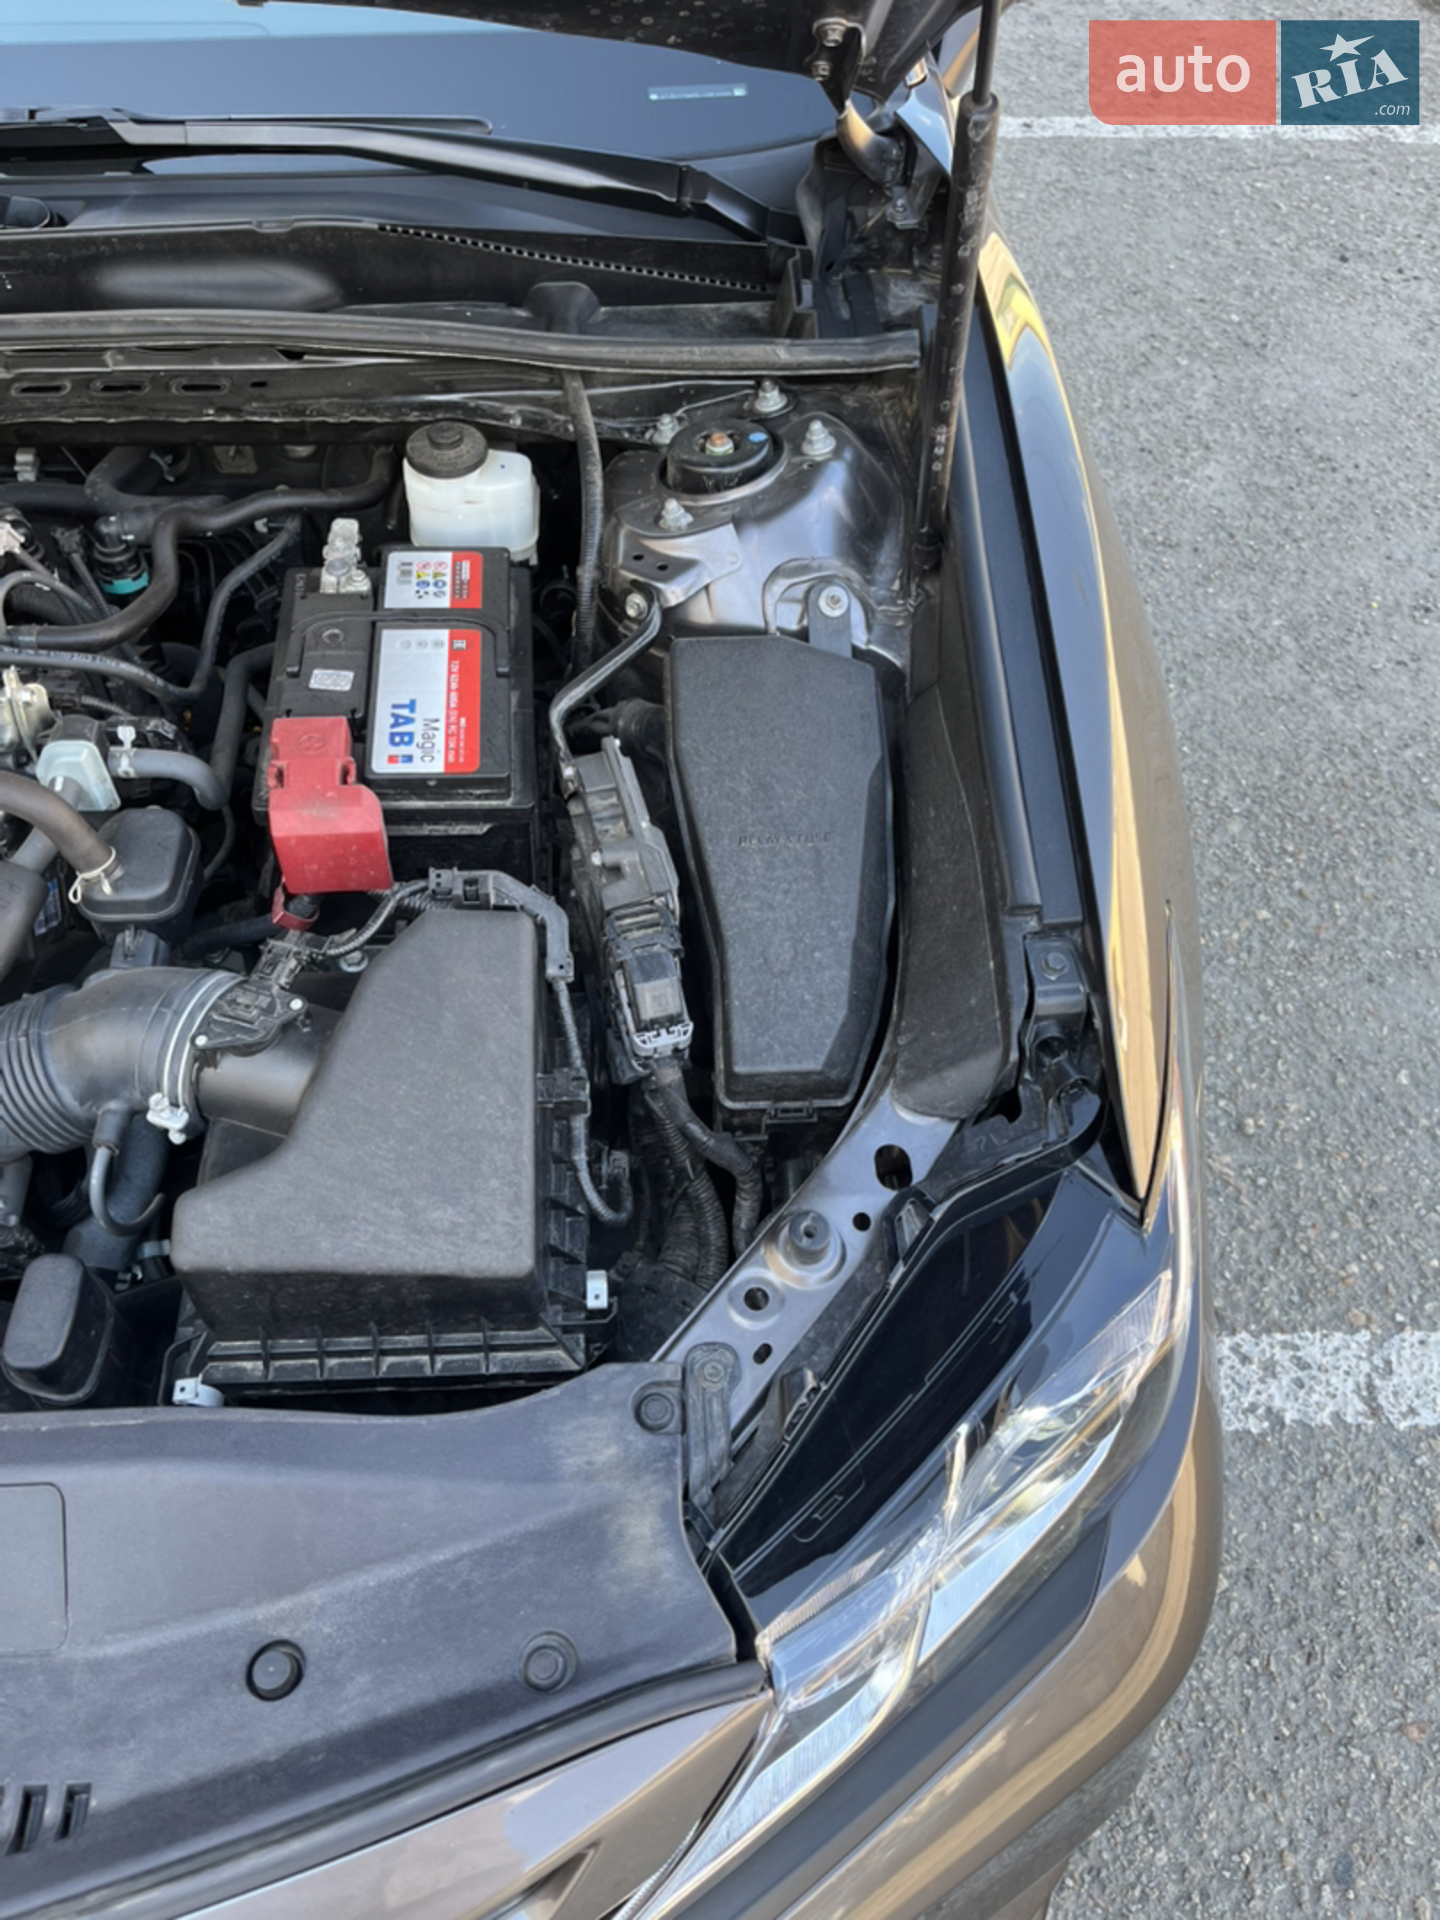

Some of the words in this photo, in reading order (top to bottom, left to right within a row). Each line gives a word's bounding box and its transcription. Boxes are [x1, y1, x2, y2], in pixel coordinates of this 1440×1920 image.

[450, 660, 459, 673] 12V
[388, 699, 417, 747] TAB
[416, 717, 441, 764] Magic
